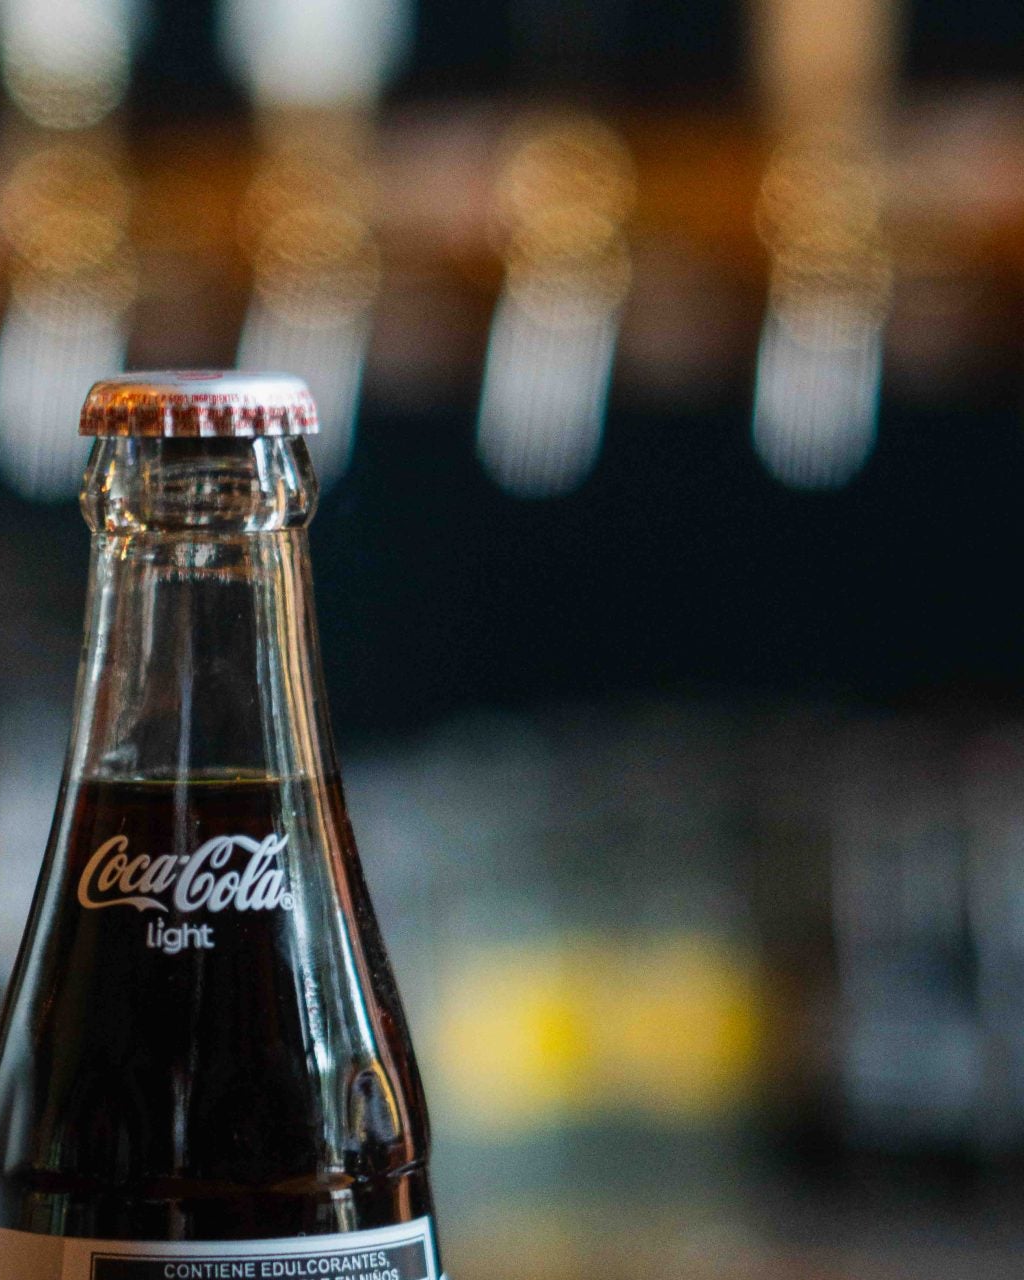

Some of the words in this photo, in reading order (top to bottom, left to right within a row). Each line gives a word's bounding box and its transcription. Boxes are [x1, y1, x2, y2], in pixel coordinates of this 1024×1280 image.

[77, 834, 289, 912] Coca-Cola
[146, 917, 215, 954] light
[164, 1262, 256, 1279] CONTIENE
[261, 1251, 390, 1277] EDULCORANTES,
